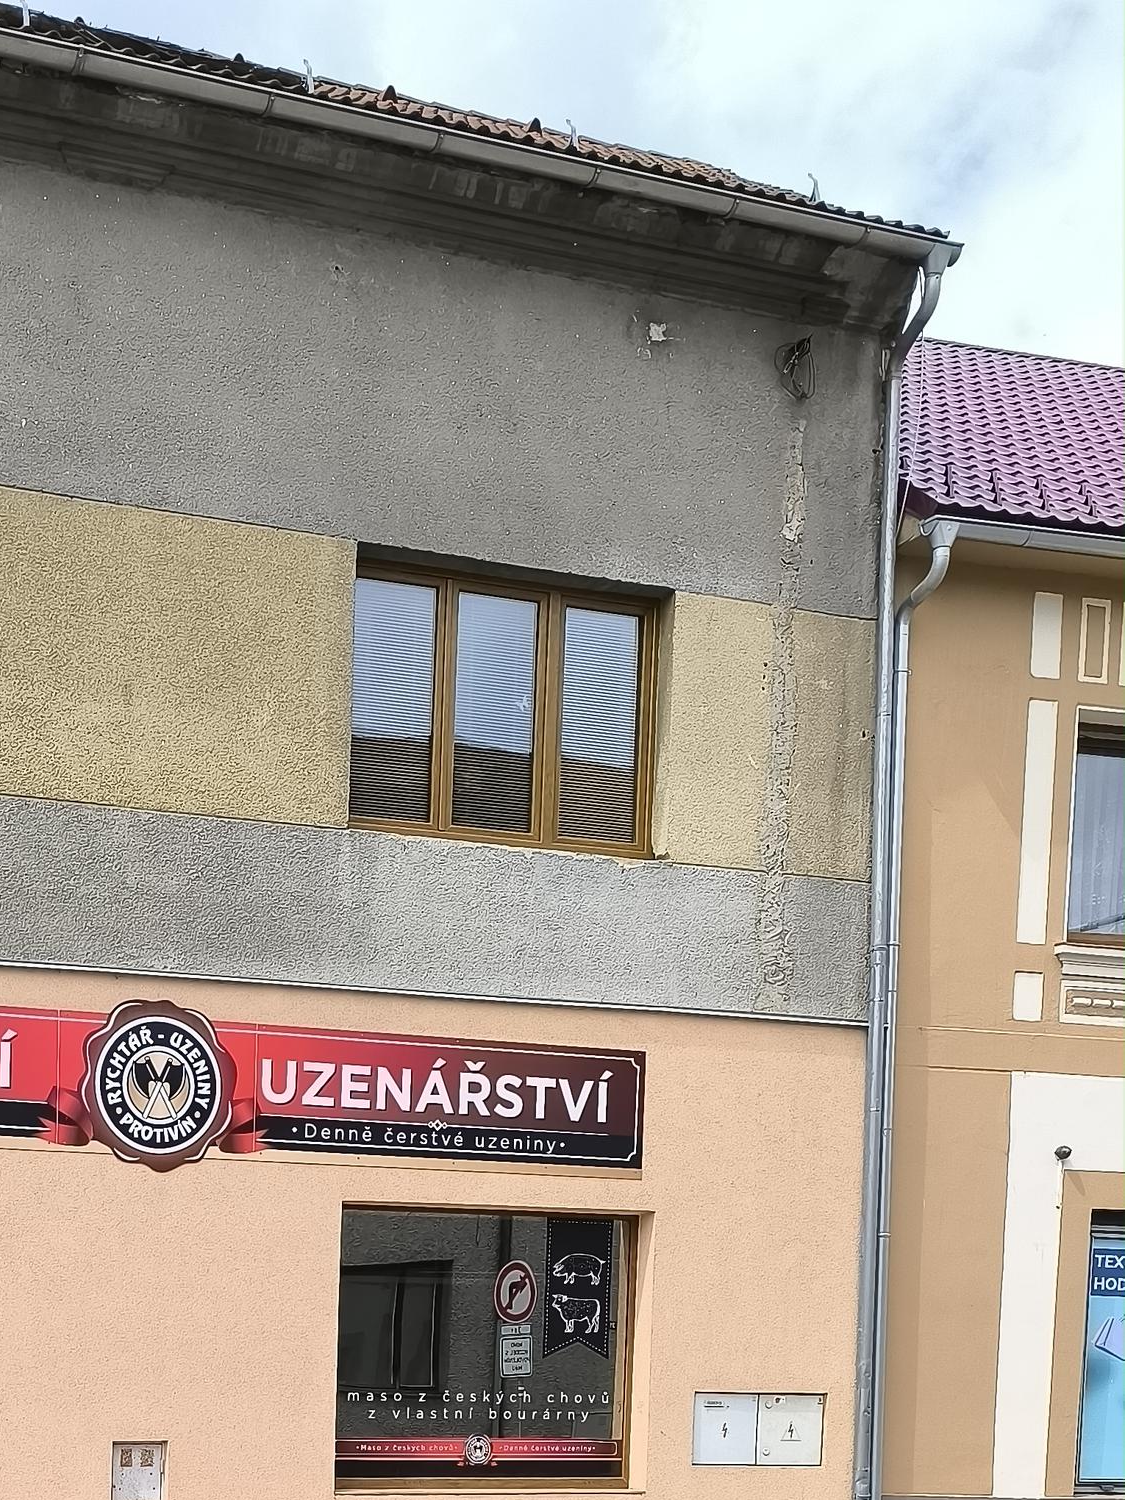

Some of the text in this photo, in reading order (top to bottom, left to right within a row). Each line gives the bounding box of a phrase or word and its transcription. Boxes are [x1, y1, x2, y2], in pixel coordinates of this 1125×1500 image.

[105, 1026, 211, 1109] RYCHTÁŘ UZENINY
[260, 1056, 611, 1123] UZENÁŘSTVÍ
[119, 1113, 197, 1143] PROTIVÍN
[304, 1122, 557, 1155] Denně čerstvé uzeniny
[1095, 1254, 1125, 1269] TEX
[347, 1390, 609, 1405] maso z českých chovů
[368, 1406, 589, 1422] z vlastní bourárny
